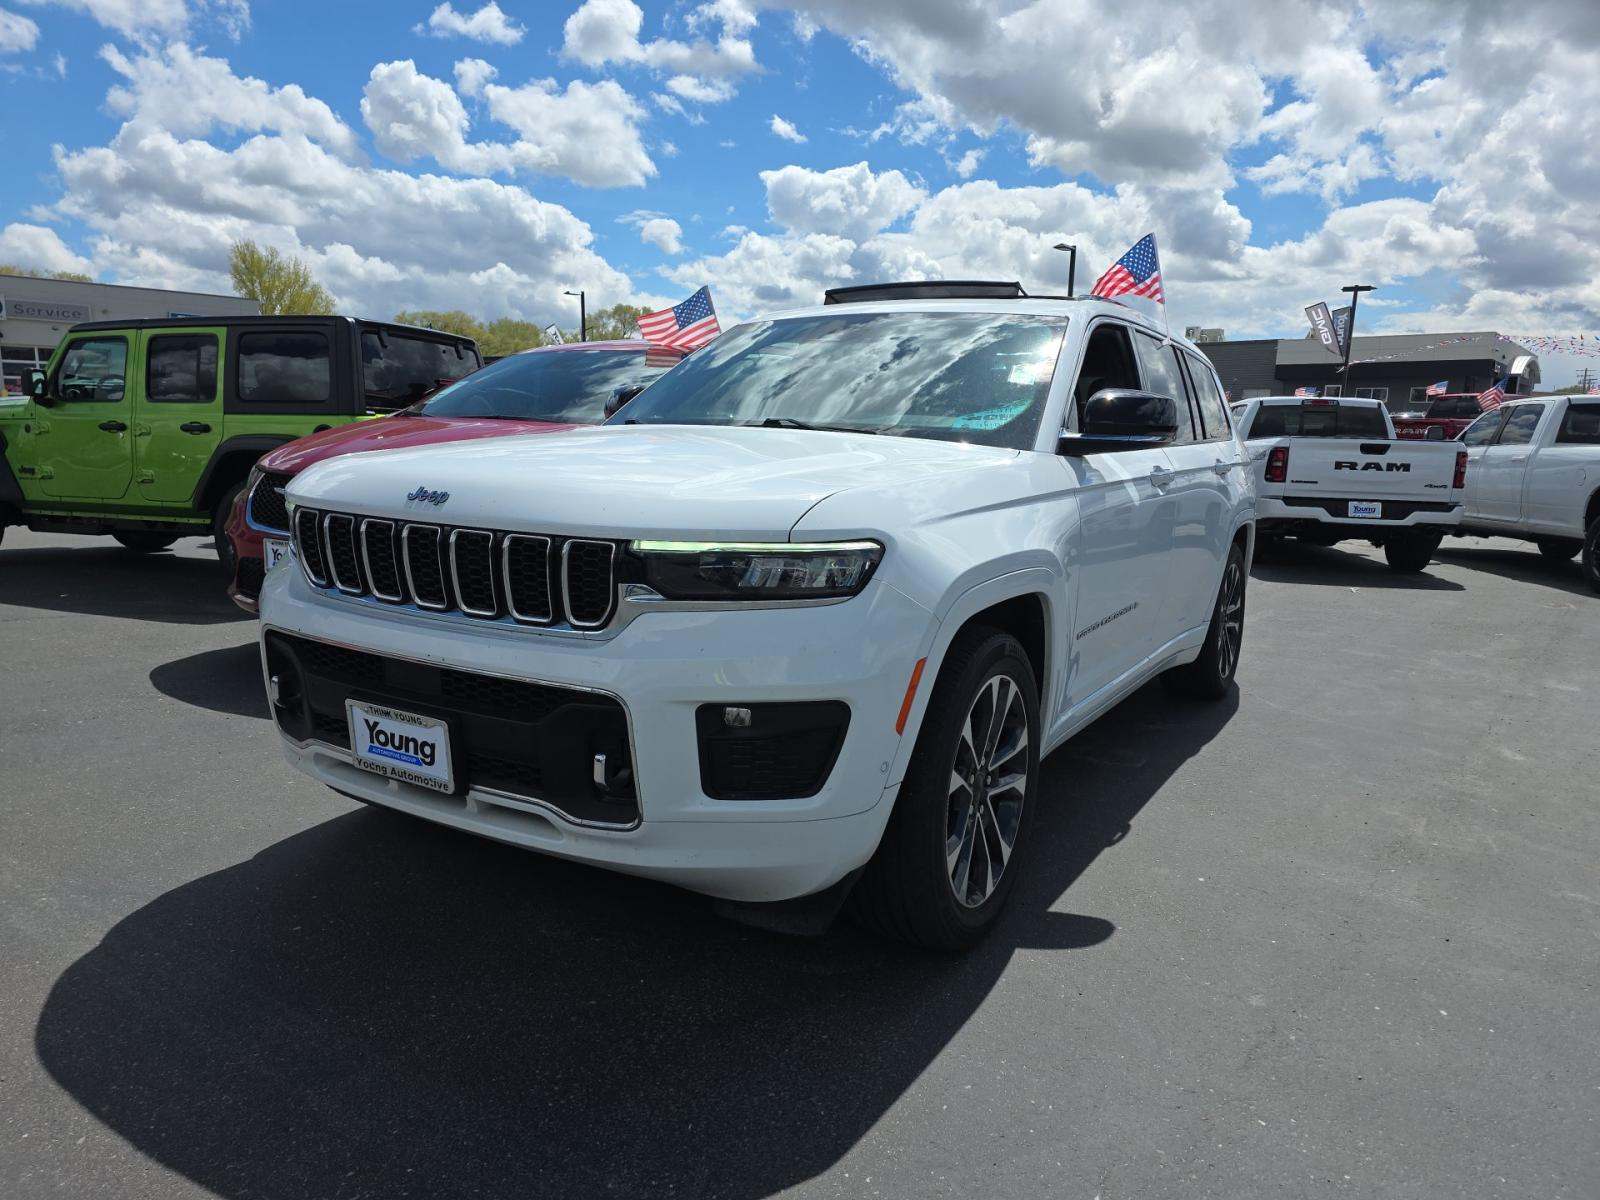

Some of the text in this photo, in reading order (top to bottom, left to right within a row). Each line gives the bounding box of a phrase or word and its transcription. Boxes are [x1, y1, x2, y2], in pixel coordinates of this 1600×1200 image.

[14, 303, 82, 319] Service
[1334, 461, 1411, 473] RAM
[407, 486, 450, 506] Jeep
[1353, 504, 1377, 514] Young
[369, 706, 423, 726] THINK YOUNG
[363, 718, 436, 766] Young
[355, 757, 449, 791] Young Automotive
